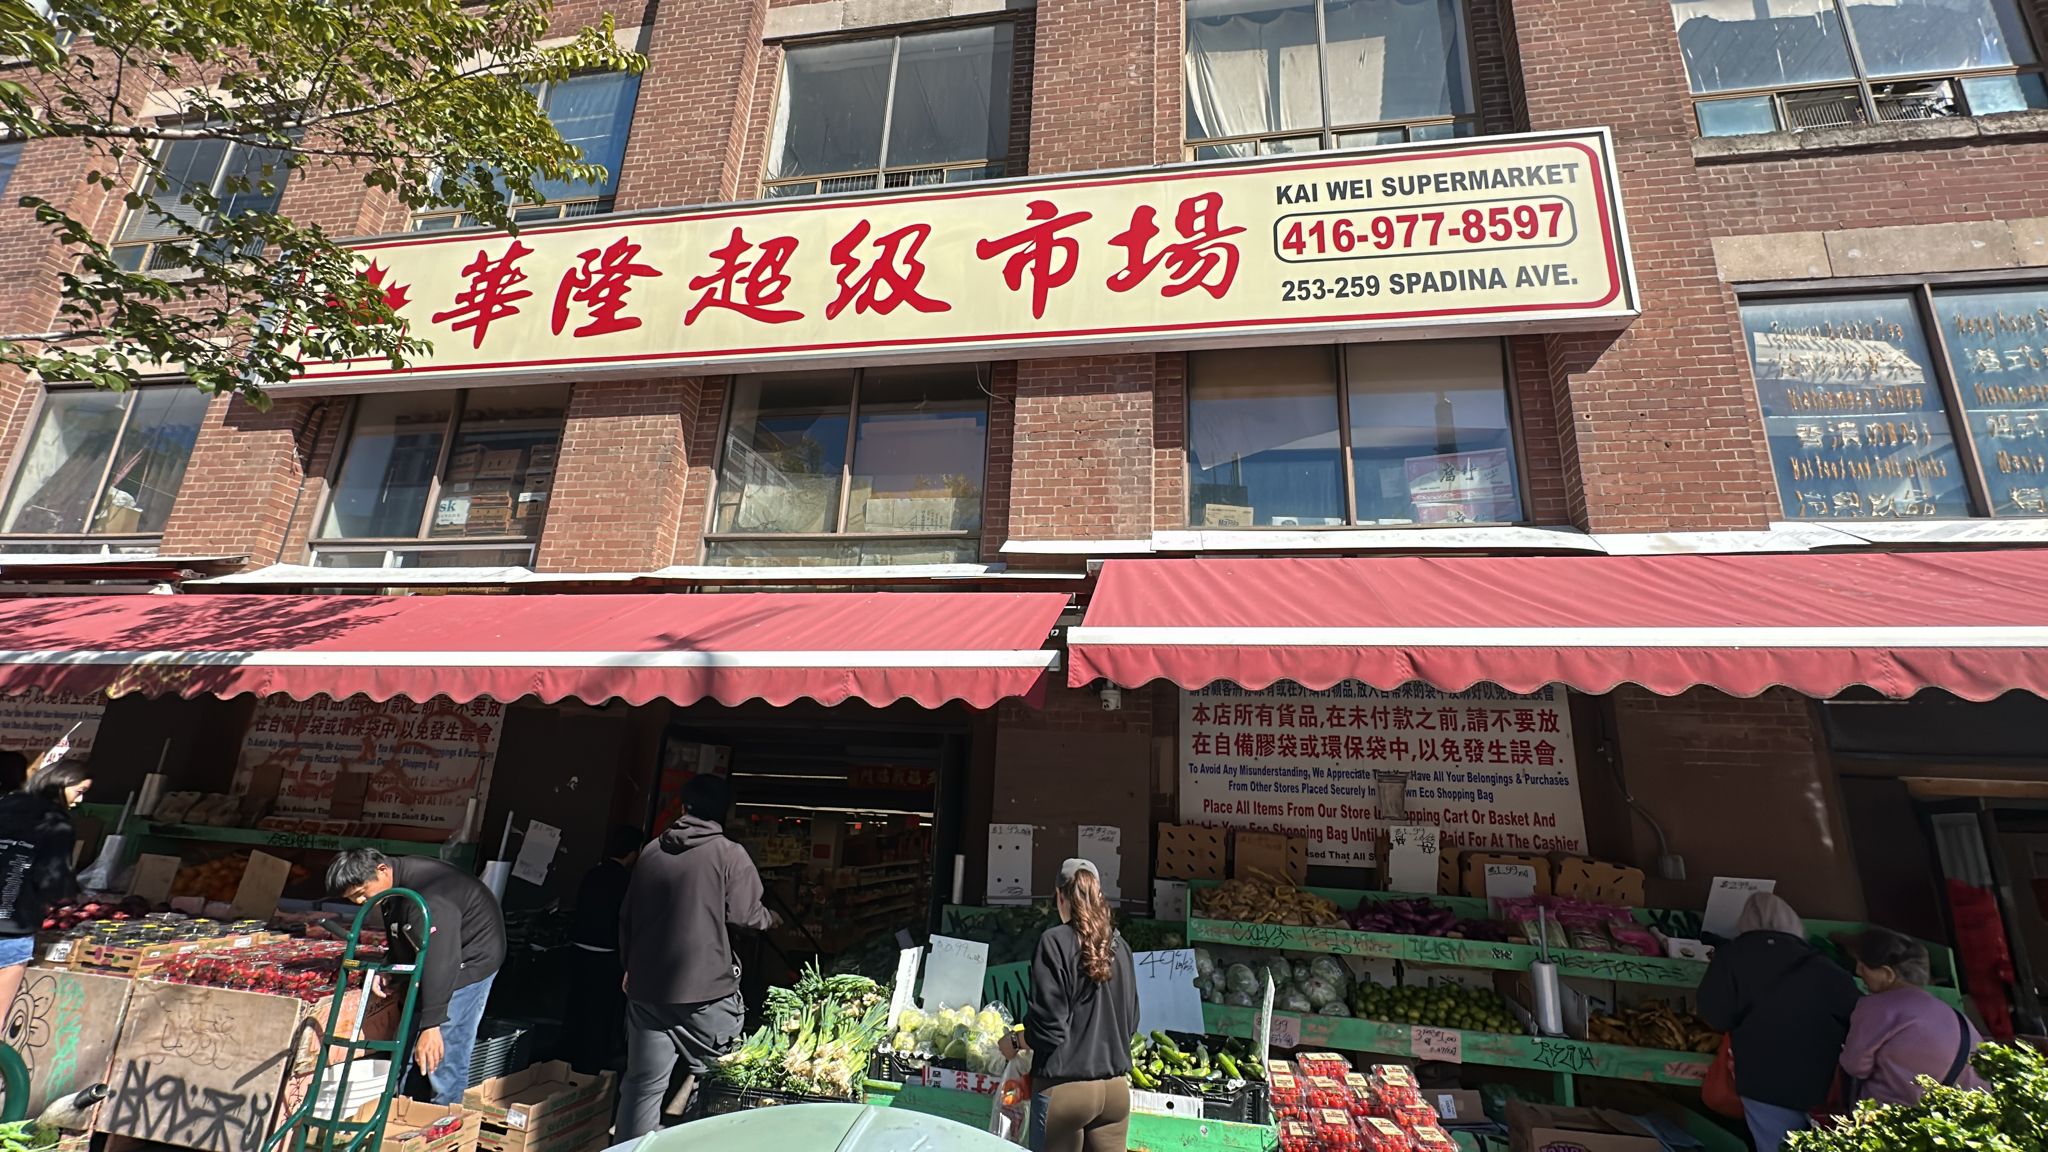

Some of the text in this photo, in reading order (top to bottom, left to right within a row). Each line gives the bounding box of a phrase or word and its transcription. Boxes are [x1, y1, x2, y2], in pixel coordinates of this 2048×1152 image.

[1276, 163, 1579, 205] KAI WEI SUPERMARKET
[1282, 203, 1564, 256] 416-977-8597
[1282, 263, 1578, 302] 253-259 SPADINA AVE.
[1192, 702, 1560, 733] 本店所有貨品,在未付款之前,請不要放
[1192, 732, 1563, 766] 在自備膠袋或環保袋中,以免發生誤會.
[1189, 763, 1198, 774] To
[1200, 764, 1221, 775] Avoid
[1223, 765, 1238, 777] Any
[1240, 765, 1311, 780] Misunderstanding,
[1312, 767, 1325, 778] We
[1327, 768, 1371, 781] Appreciate
[1411, 770, 1431, 781] Have
[1433, 771, 1444, 782] All
[1446, 772, 1465, 783] Your
[1467, 772, 1513, 786] Belongings
[1516, 774, 1522, 784] &
[1525, 774, 1569, 786] Purchases
[1228, 780, 1248, 791] From
[1250, 781, 1272, 793] Other
[1274, 782, 1299, 794] Stores
[1301, 783, 1329, 795] Placed
[1330, 784, 1366, 798] Securely
[1368, 785, 1376, 796] In
[1419, 787, 1435, 799] Eco
[1437, 787, 1475, 802] Shopping
[1477, 789, 1494, 802] Bag
[1203, 799, 1233, 813] Place
[1236, 800, 1250, 815] All
[1253, 801, 1284, 816] Items
[1287, 803, 1315, 817] From
[1318, 804, 1337, 818] Our
[1340, 805, 1371, 820] Store
[1443, 810, 1469, 824] Cart
[1472, 811, 1485, 824] Or
[1489, 811, 1528, 827] Basket
[1533, 813, 1556, 827] And
[1326, 826, 1348, 844] Bag
[1351, 827, 1376, 842] Until
[1440, 831, 1464, 847] Paid
[1468, 832, 1491, 848] For
[1493, 832, 1504, 849] At
[1506, 834, 1530, 849] The
[1532, 835, 1579, 851] Cashier
[1329, 851, 1350, 860] That
[1353, 852, 1367, 861] All
